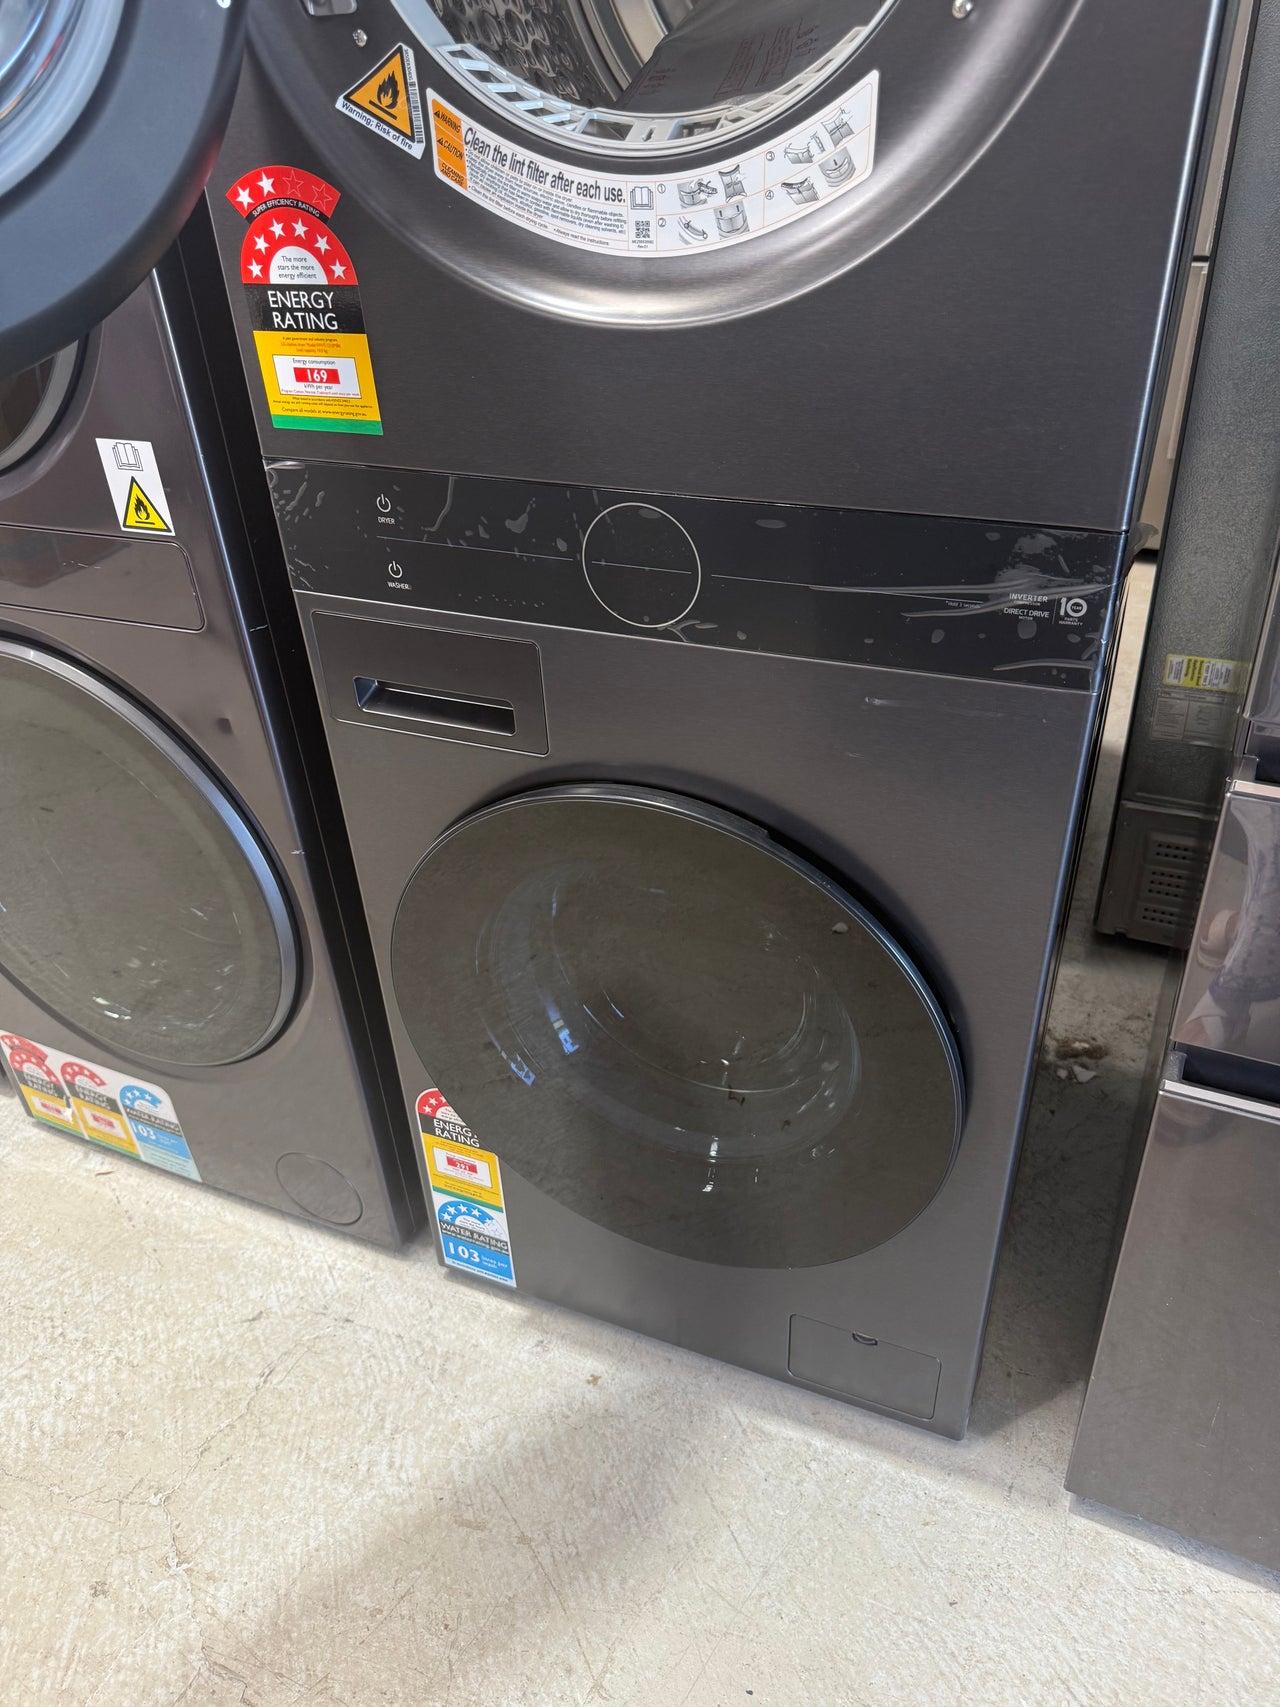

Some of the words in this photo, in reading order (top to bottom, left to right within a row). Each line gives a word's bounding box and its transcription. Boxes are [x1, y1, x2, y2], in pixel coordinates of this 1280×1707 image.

[440, 112, 461, 133] WARNING
[375, 121, 392, 137] Risk
[392, 133, 400, 141] of
[400, 138, 413, 150] fire
[443, 140, 464, 160] CAUTION
[440, 168, 450, 177] AND
[441, 163, 464, 181] CLEANING
[465, 128, 491, 158] Clean
[492, 145, 508, 167] the
[509, 152, 526, 176] lint
[526, 160, 549, 185] filter
[550, 171, 574, 194] after
[576, 180, 600, 200] each
[604, 186, 626, 203] use.
[252, 203, 267, 217] SUPER
[267, 198, 297, 207] EFFICIENCY
[298, 200, 320, 217] RATING
[267, 290, 333, 309] ENERGY
[272, 312, 338, 330] RATING
[292, 358, 307, 366] Energy
[307, 369, 327, 382] 169
[377, 516, 396, 525] DRYER
[387, 581, 409, 590] WASHER
[1009, 593, 1048, 603] INVERTER
[1060, 598, 1088, 617] 10
[1003, 607, 1027, 616] DIRECT
[1028, 610, 1050, 618] DRIVE
[130, 1120, 156, 1140] 103
[433, 1118, 478, 1138] ENERG
[435, 1128, 480, 1148] RATING
[440, 1222, 472, 1238] WATER
[473, 1232, 508, 1250] RATING
[448, 1242, 480, 1263] 103
